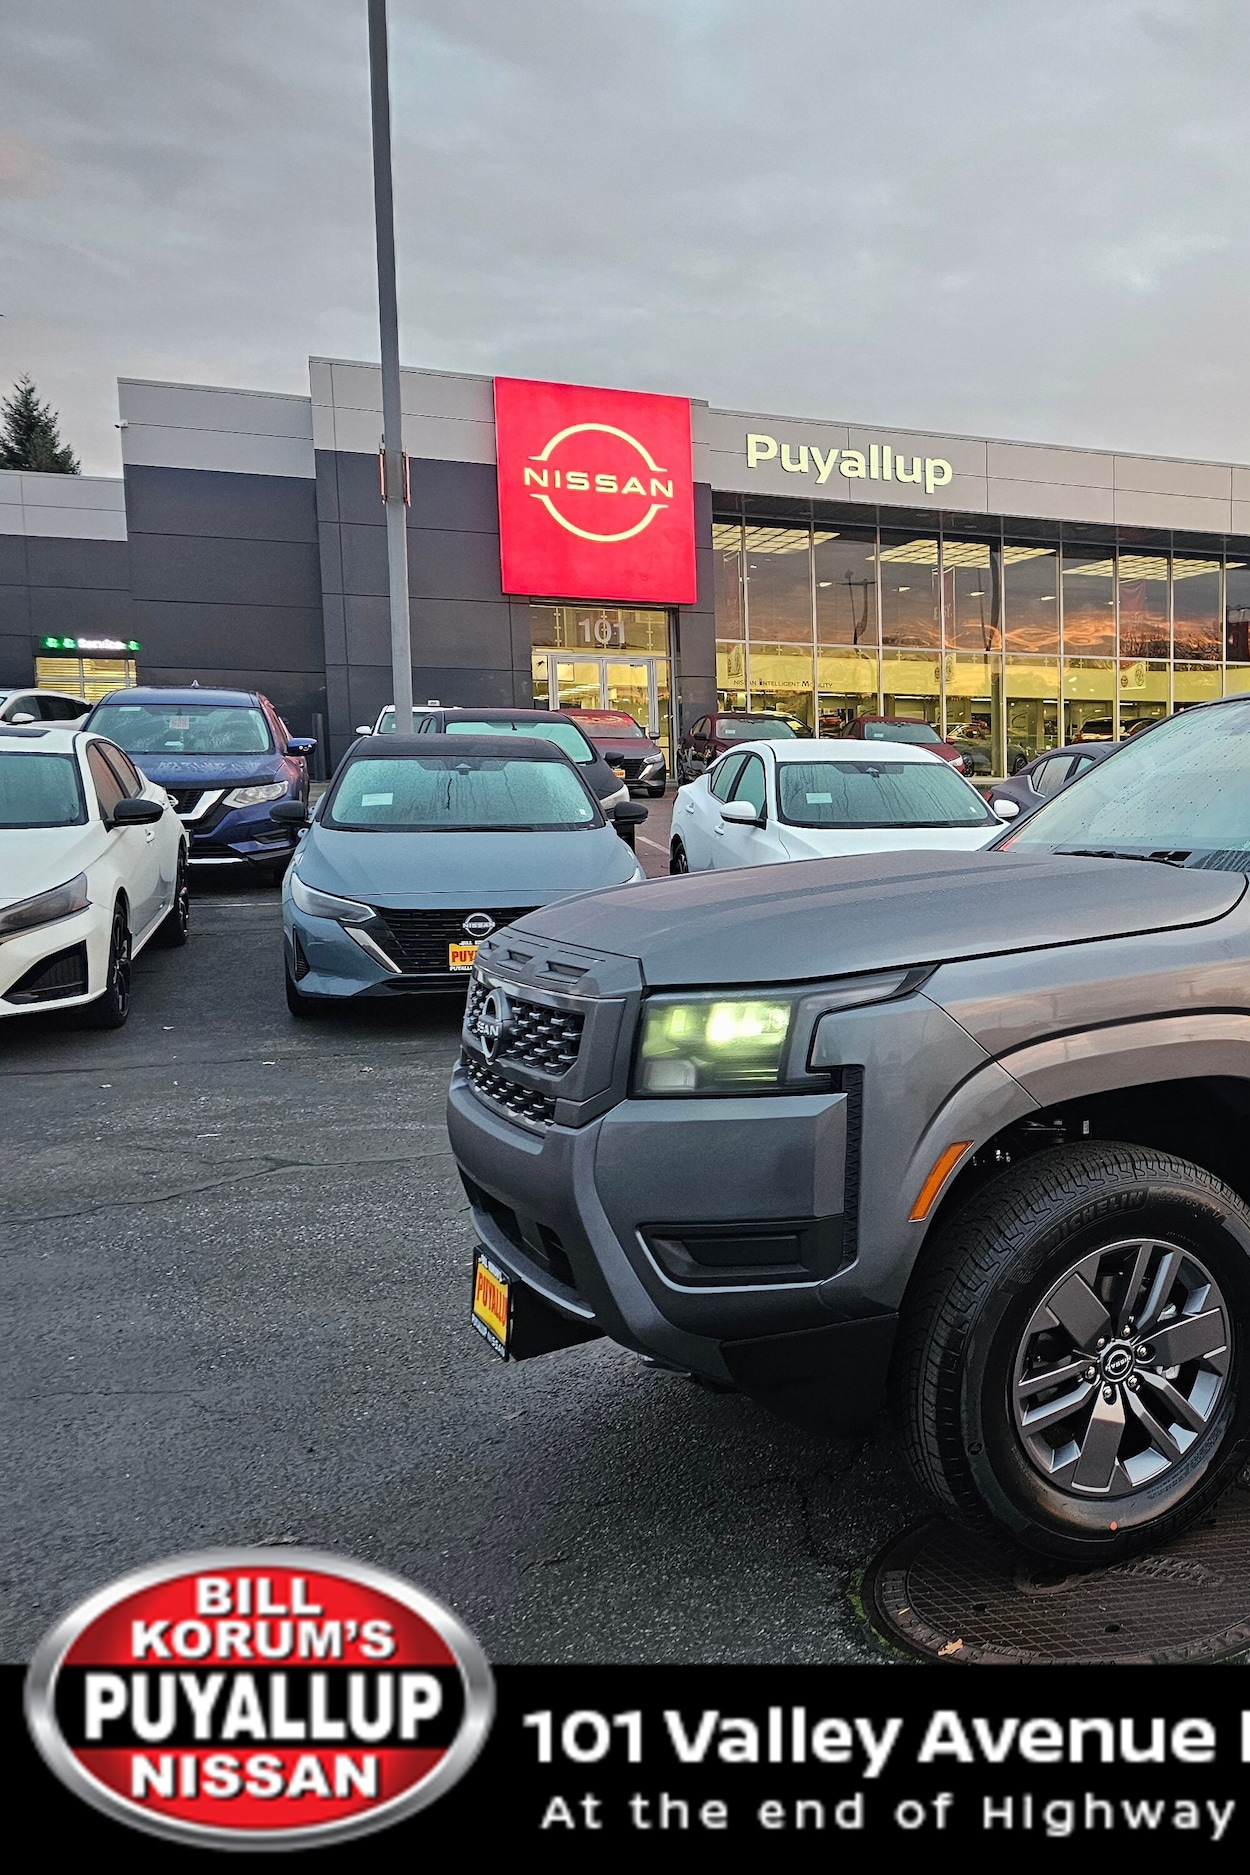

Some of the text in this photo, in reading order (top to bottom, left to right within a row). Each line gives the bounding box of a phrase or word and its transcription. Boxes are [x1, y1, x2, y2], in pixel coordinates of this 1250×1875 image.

[746, 433, 953, 494] Puyallup
[524, 466, 674, 498] NISSAN
[578, 617, 627, 644] 101
[462, 921, 496, 929] NISSAN
